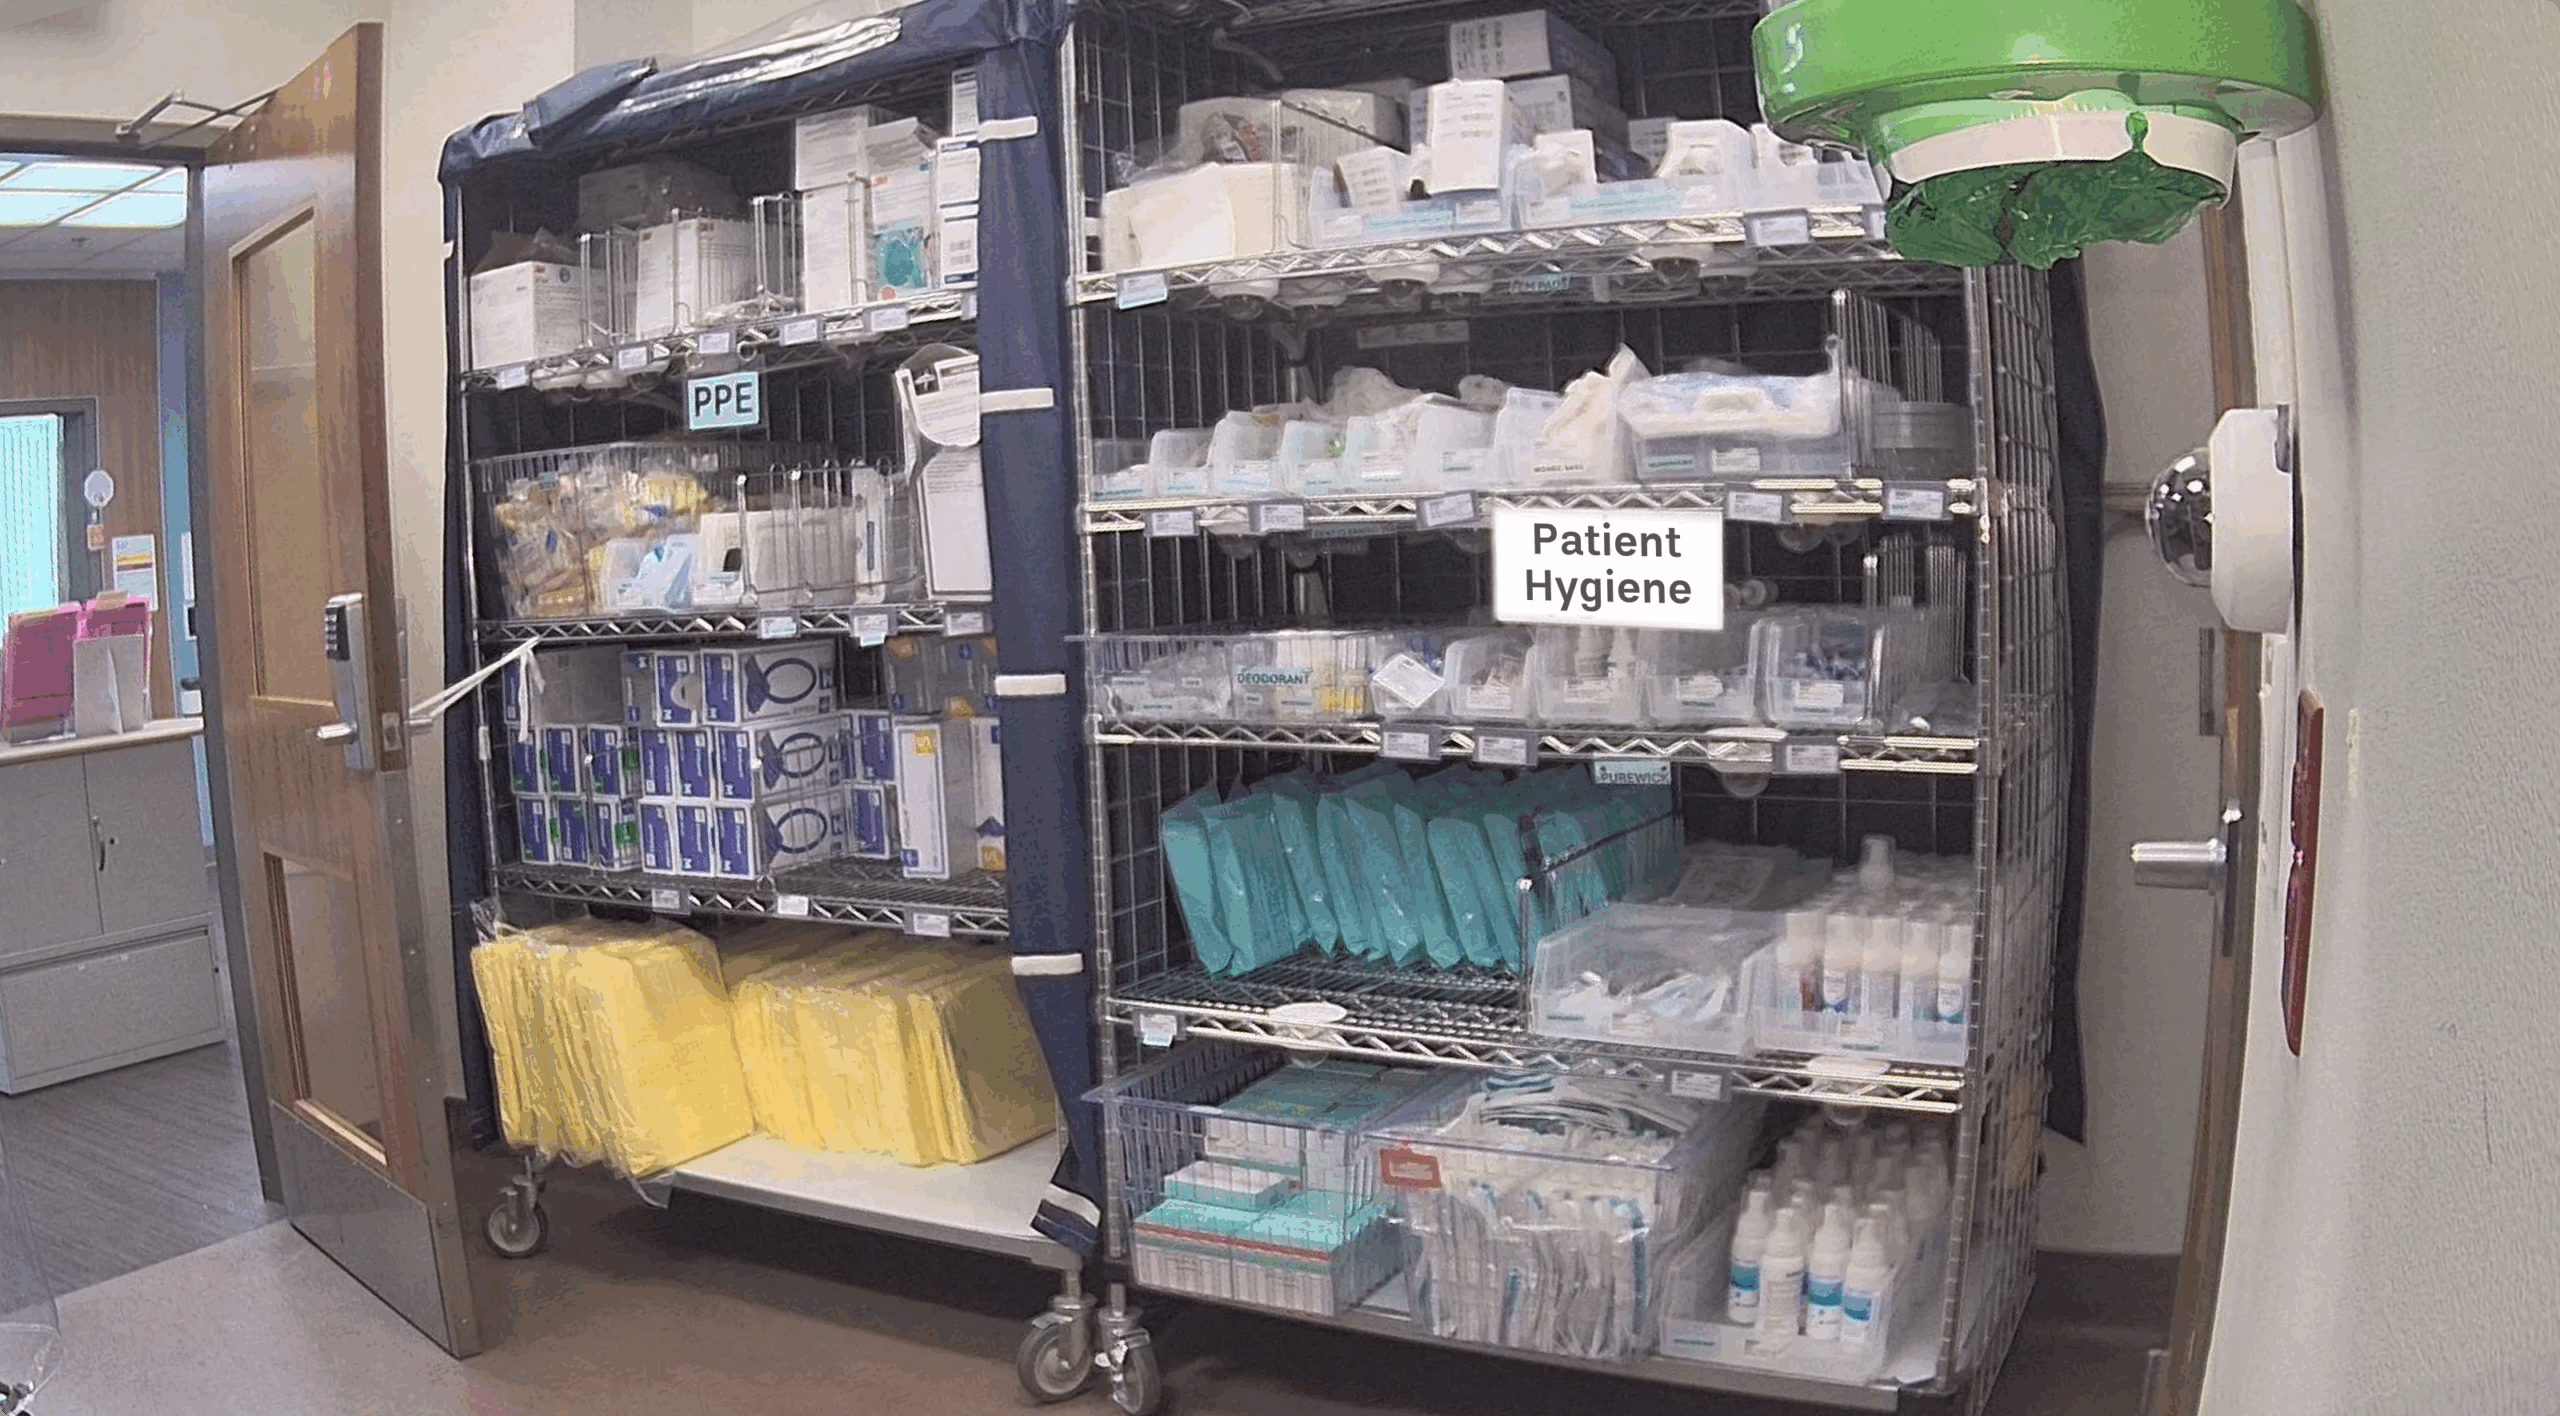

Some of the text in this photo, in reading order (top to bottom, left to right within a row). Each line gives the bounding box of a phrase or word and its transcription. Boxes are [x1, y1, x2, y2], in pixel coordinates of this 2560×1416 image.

[695, 382, 753, 417] PPE
[1533, 522, 1682, 557] Patient
[1526, 568, 1692, 612] Hygiene
[1237, 672, 1311, 685] DEODORANT
[1601, 771, 1670, 785] PUREWICK
